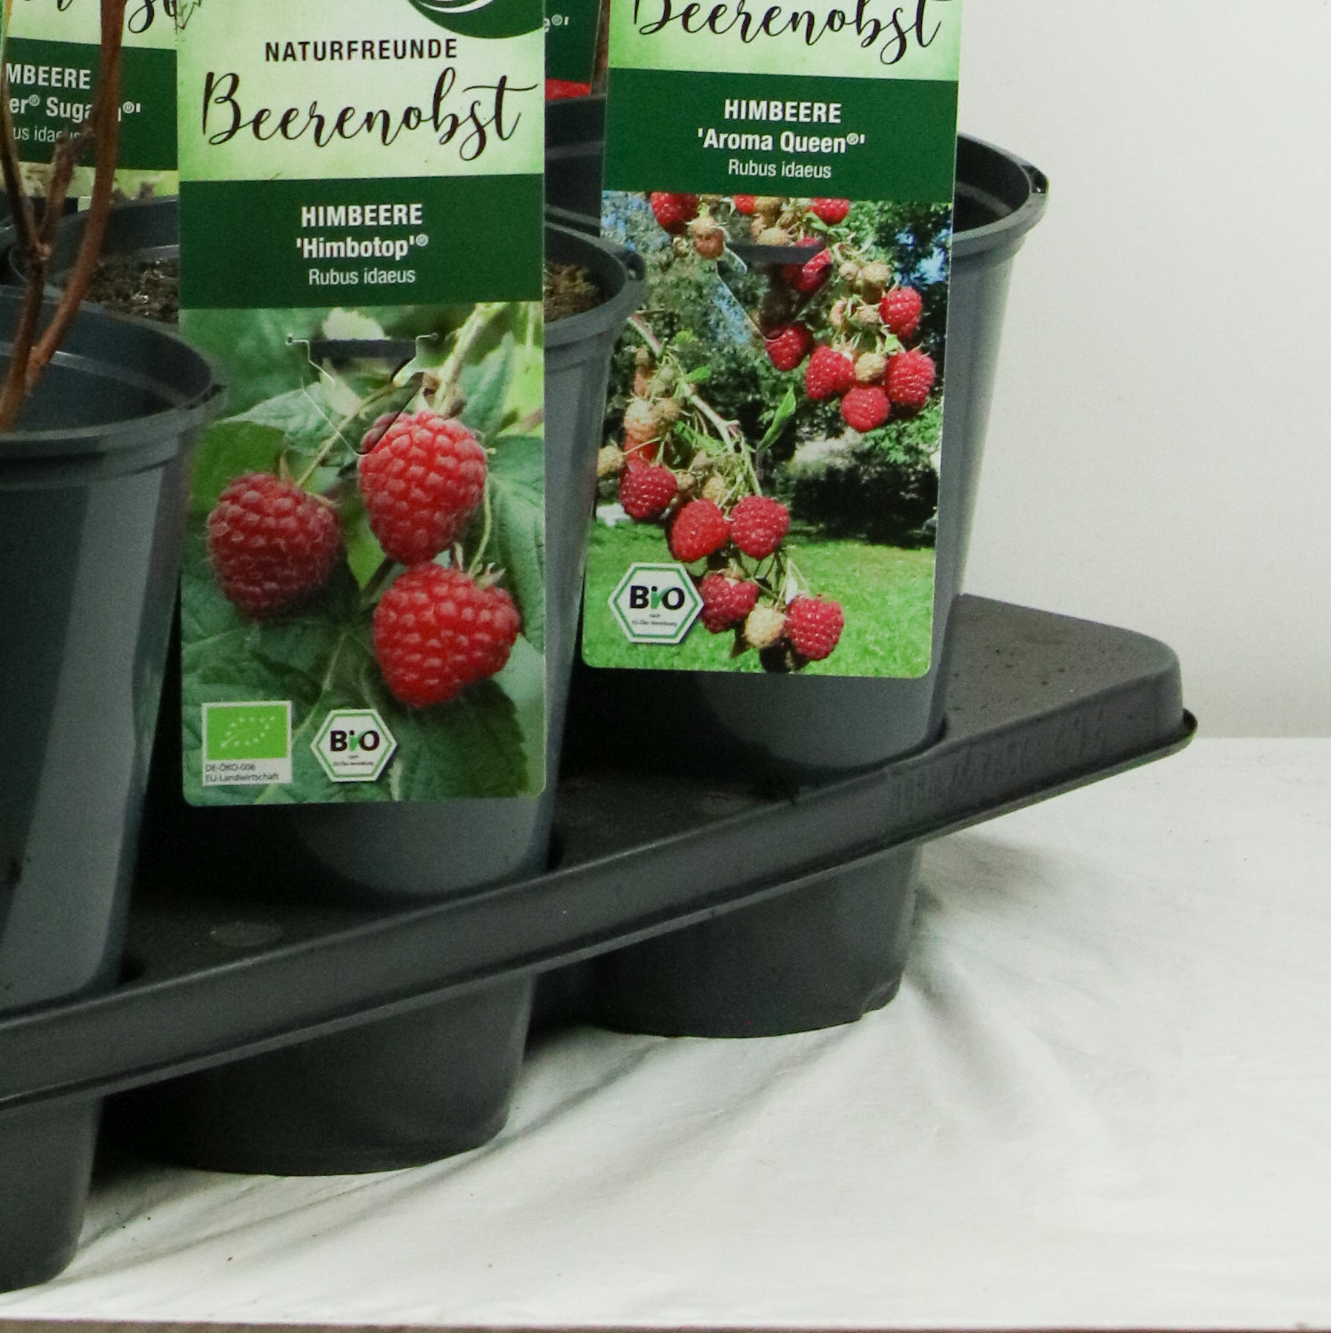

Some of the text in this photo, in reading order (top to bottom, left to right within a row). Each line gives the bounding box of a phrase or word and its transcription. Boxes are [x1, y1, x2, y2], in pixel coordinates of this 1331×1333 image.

[265, 38, 458, 62] NATURFREUNDE
[202, 66, 539, 162] Beerenobst
[724, 98, 842, 124] HIMBEERE
[728, 158, 832, 179] Rubus idaeus
[300, 203, 423, 228] HIMBEERE
[308, 267, 416, 287] Rubus idaeus
